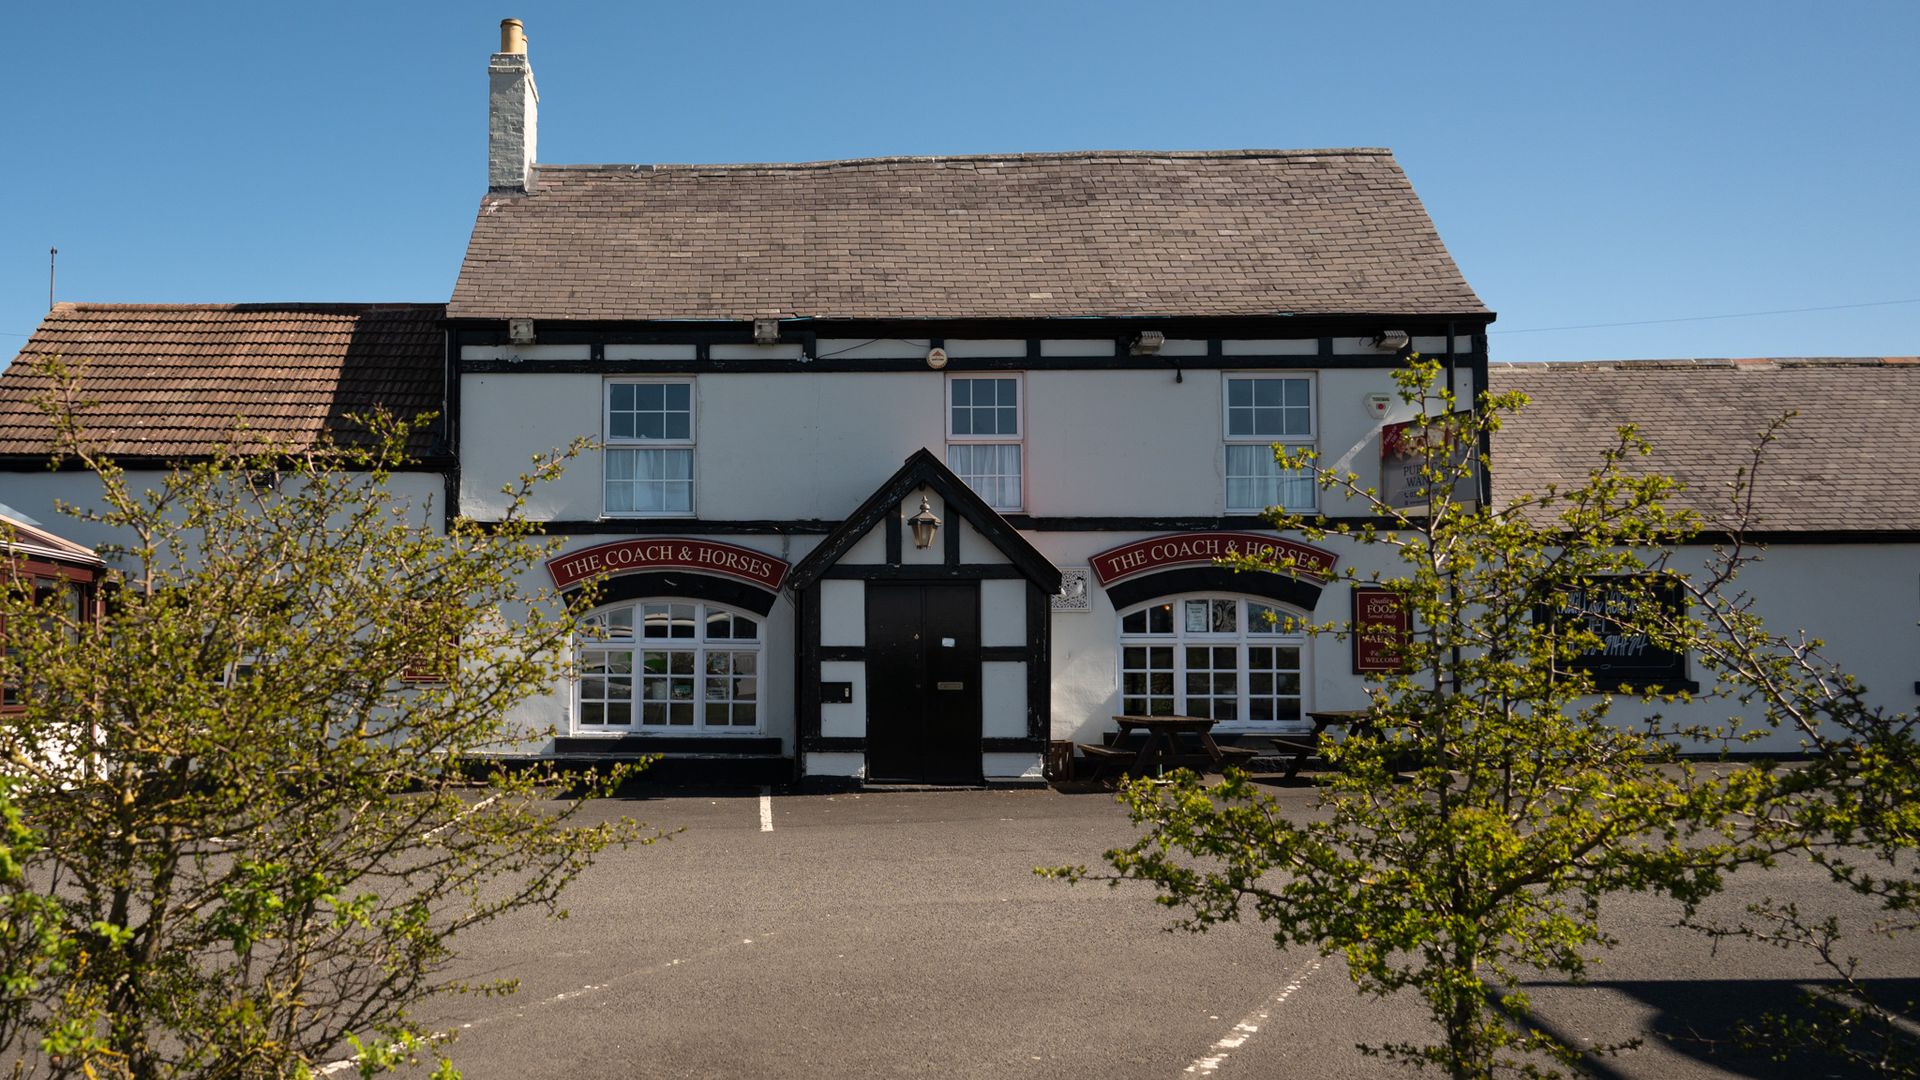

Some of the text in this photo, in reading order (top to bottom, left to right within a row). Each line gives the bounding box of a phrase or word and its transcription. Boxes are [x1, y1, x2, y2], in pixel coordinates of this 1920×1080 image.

[562, 545, 772, 578] THE COACH & HORSES
[1108, 540, 1320, 573] THE COACH & HORSES
